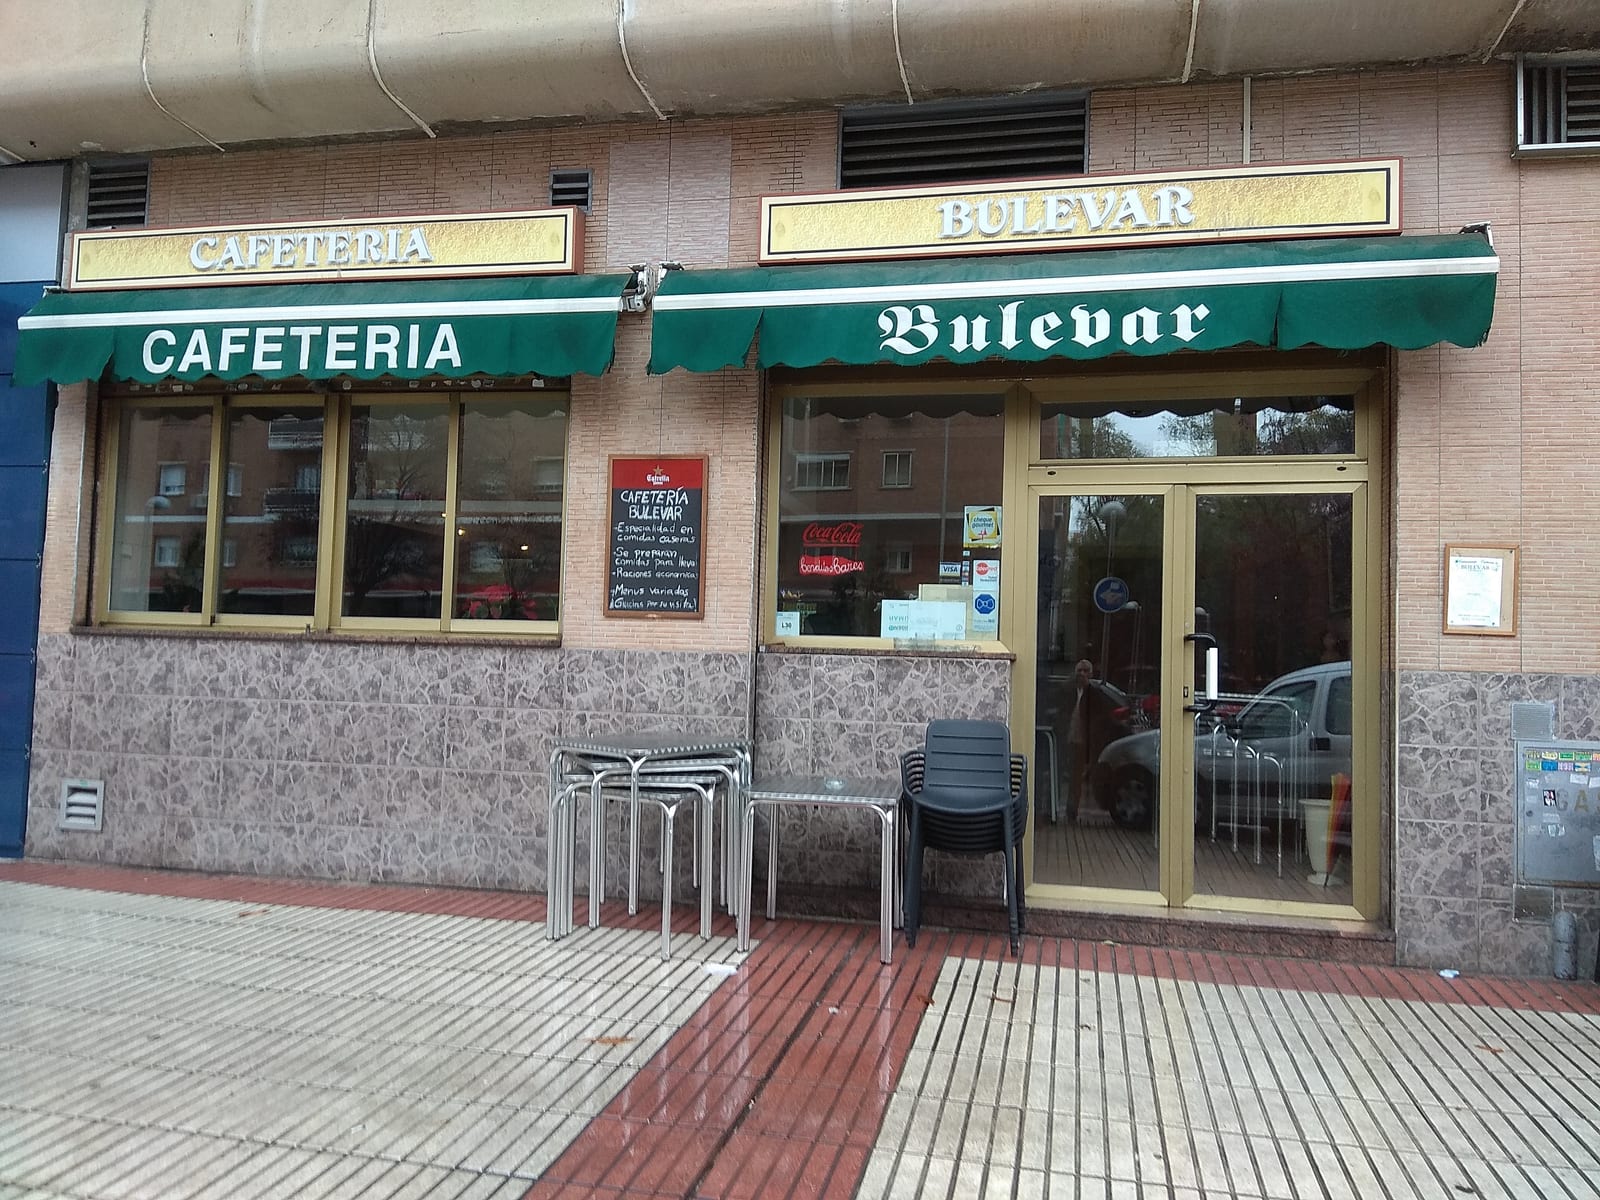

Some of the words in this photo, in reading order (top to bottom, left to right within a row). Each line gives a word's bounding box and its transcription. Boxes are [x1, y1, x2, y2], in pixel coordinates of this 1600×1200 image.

[938, 185, 1195, 240] BULEVAR
[189, 226, 433, 271] CAFETERIA
[877, 298, 1211, 356] Bulevar
[141, 323, 464, 375] CAFETERIA
[620, 486, 689, 505] CAFETERÍA
[628, 505, 683, 521] BULEVAR
[617, 532, 656, 543] comidas
[659, 535, 696, 544] caseras
[680, 525, 693, 535] en
[802, 521, 864, 545] Coca-Cola
[634, 549, 678, 559] preparan
[615, 556, 650, 567] comidas
[654, 559, 675, 570] para
[649, 584, 689, 597] variados
[660, 600, 668, 608] su
